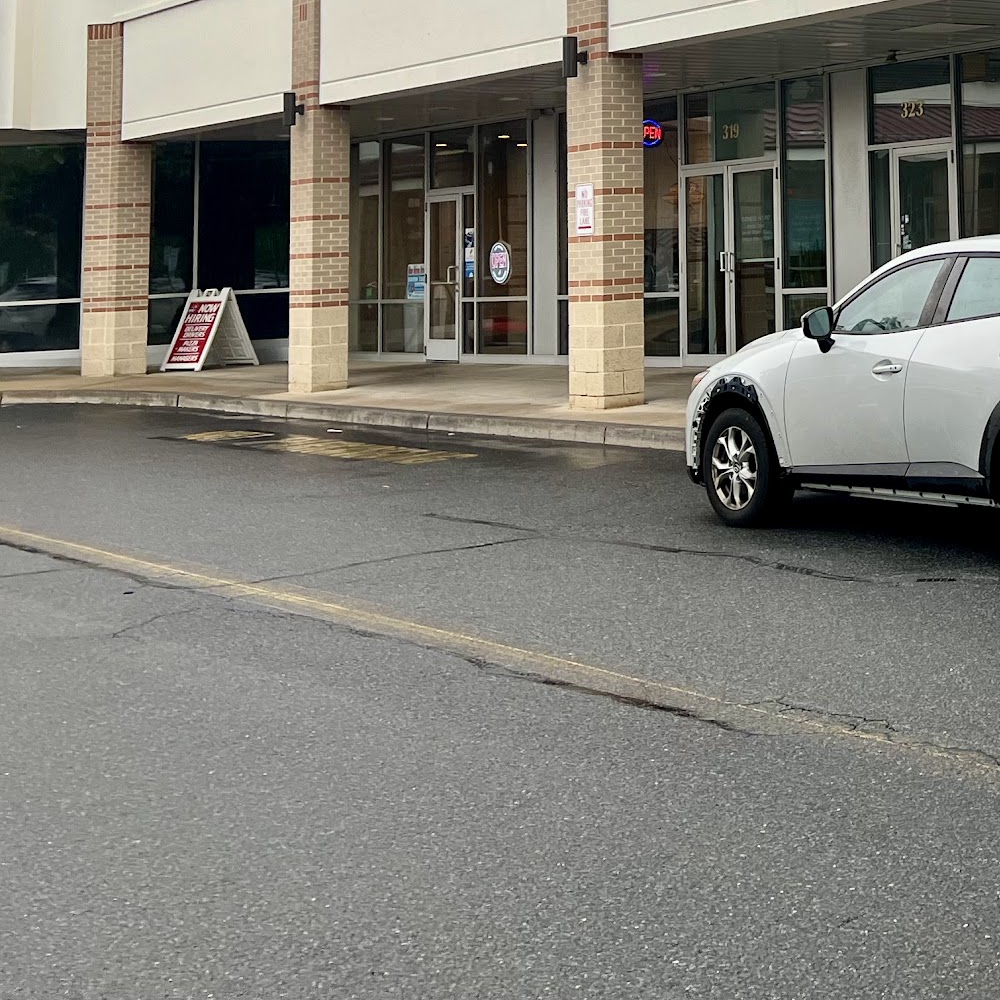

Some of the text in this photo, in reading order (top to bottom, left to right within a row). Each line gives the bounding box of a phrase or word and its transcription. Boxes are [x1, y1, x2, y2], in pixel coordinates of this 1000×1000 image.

[900, 101, 924, 118] 323
[643, 126, 662, 140] PEN
[722, 124, 740, 140] 319
[198, 303, 220, 313] NOW
[184, 313, 216, 323] HIRING
